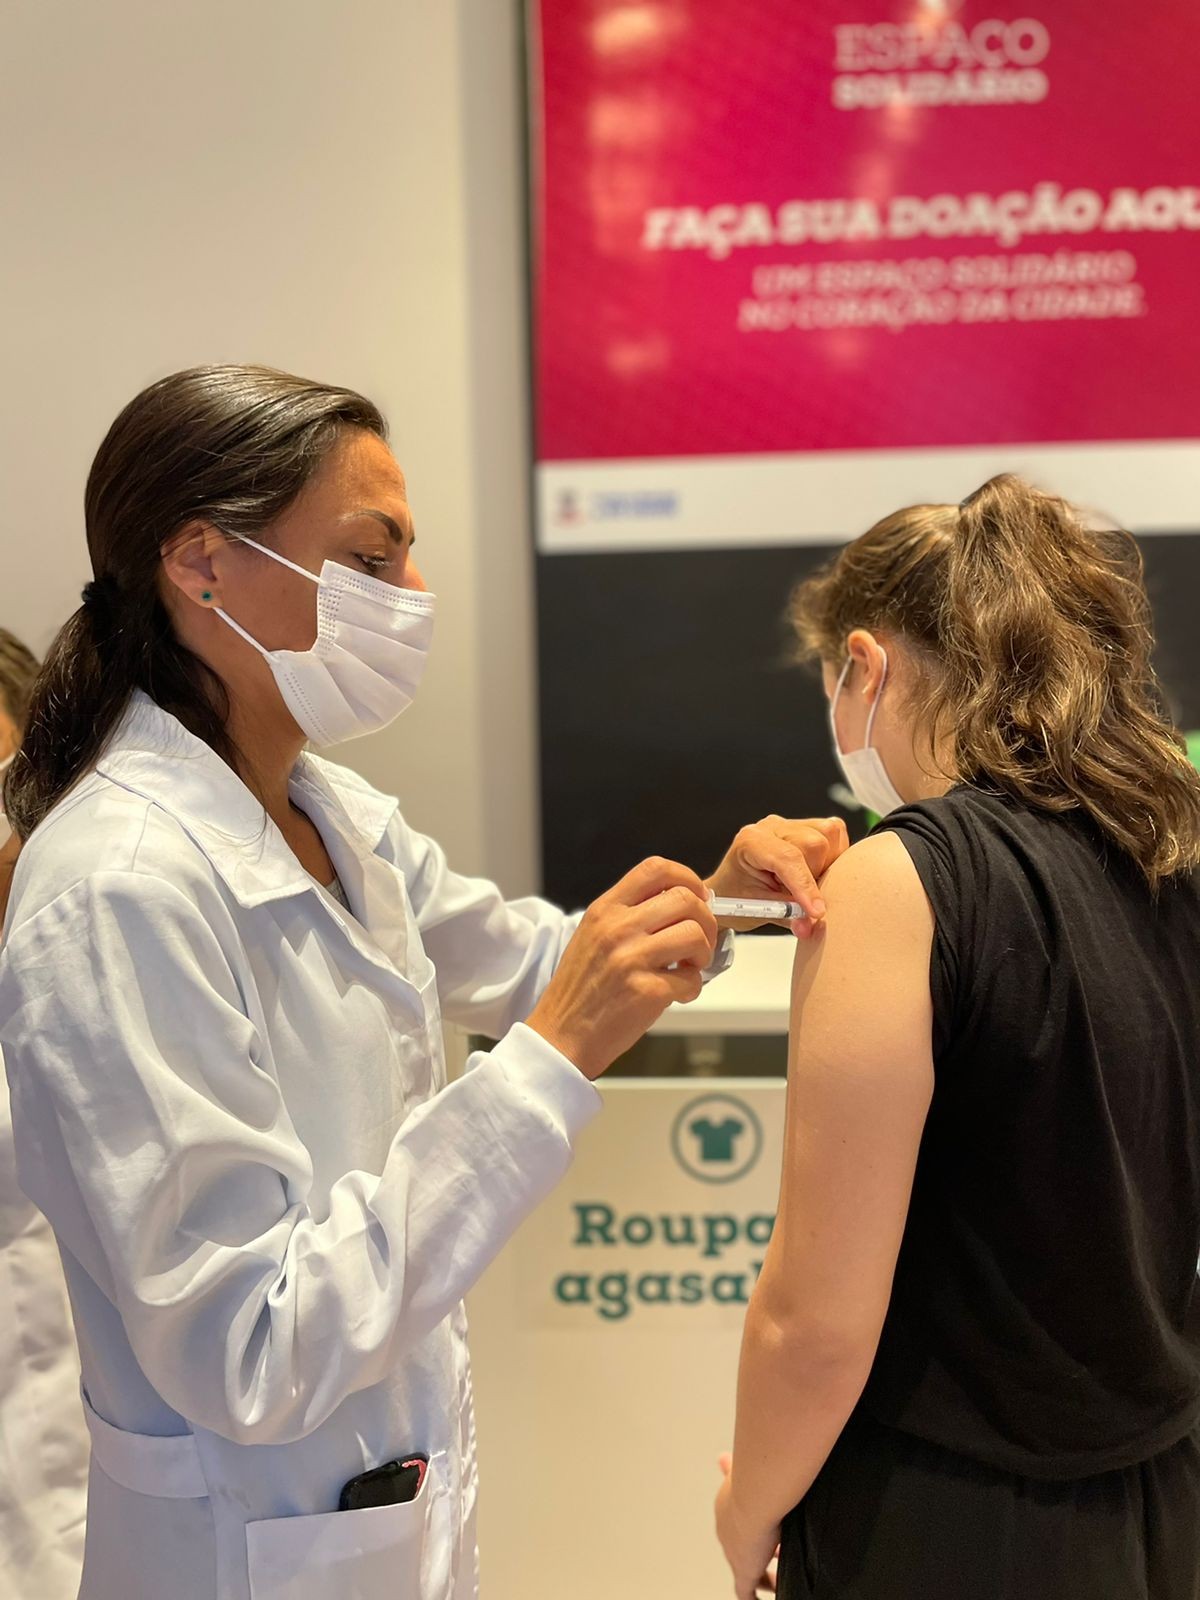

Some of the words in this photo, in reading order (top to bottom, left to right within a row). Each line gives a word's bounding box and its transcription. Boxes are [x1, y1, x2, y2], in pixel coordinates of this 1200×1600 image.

[834, 19, 1049, 71] ESPAÇO
[643, 204, 772, 259] FAÇA
[777, 200, 880, 245] SUA
[889, 183, 1101, 246] DOAÇÃO
